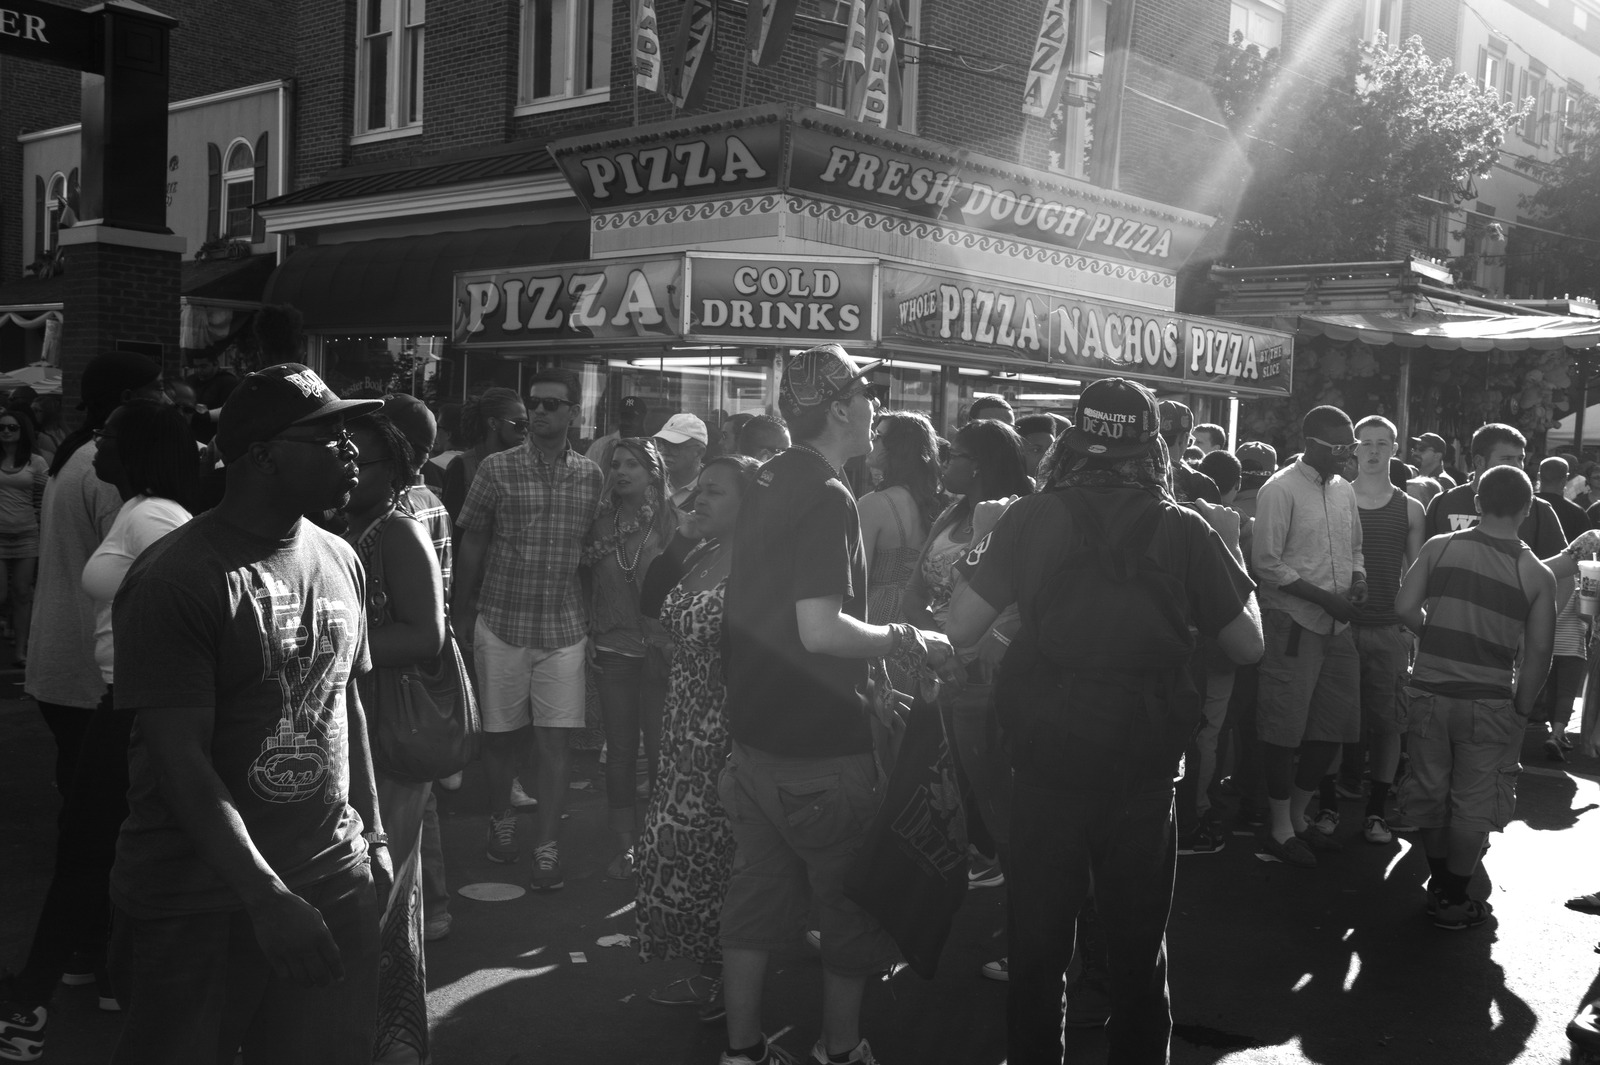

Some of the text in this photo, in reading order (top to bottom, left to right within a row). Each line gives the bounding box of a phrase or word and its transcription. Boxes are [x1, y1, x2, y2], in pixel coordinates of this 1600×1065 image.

[635, 0, 658, 78] ADE
[1022, 0, 1065, 109] ZZA
[581, 135, 767, 199] PIZZA
[819, 146, 1173, 258] FRESH DOUGH PIZZA
[465, 269, 663, 333] PIZZA
[733, 265, 840, 298] COLD
[701, 299, 860, 332] DRINKS
[898, 283, 1040, 351] WHOLE PIZZA
[1057, 304, 1179, 368] NACHOS
[1190, 327, 1259, 379] PIZZA
[1263, 362, 1281, 379] SLICE
[1082, 416, 1124, 439] DEAD
